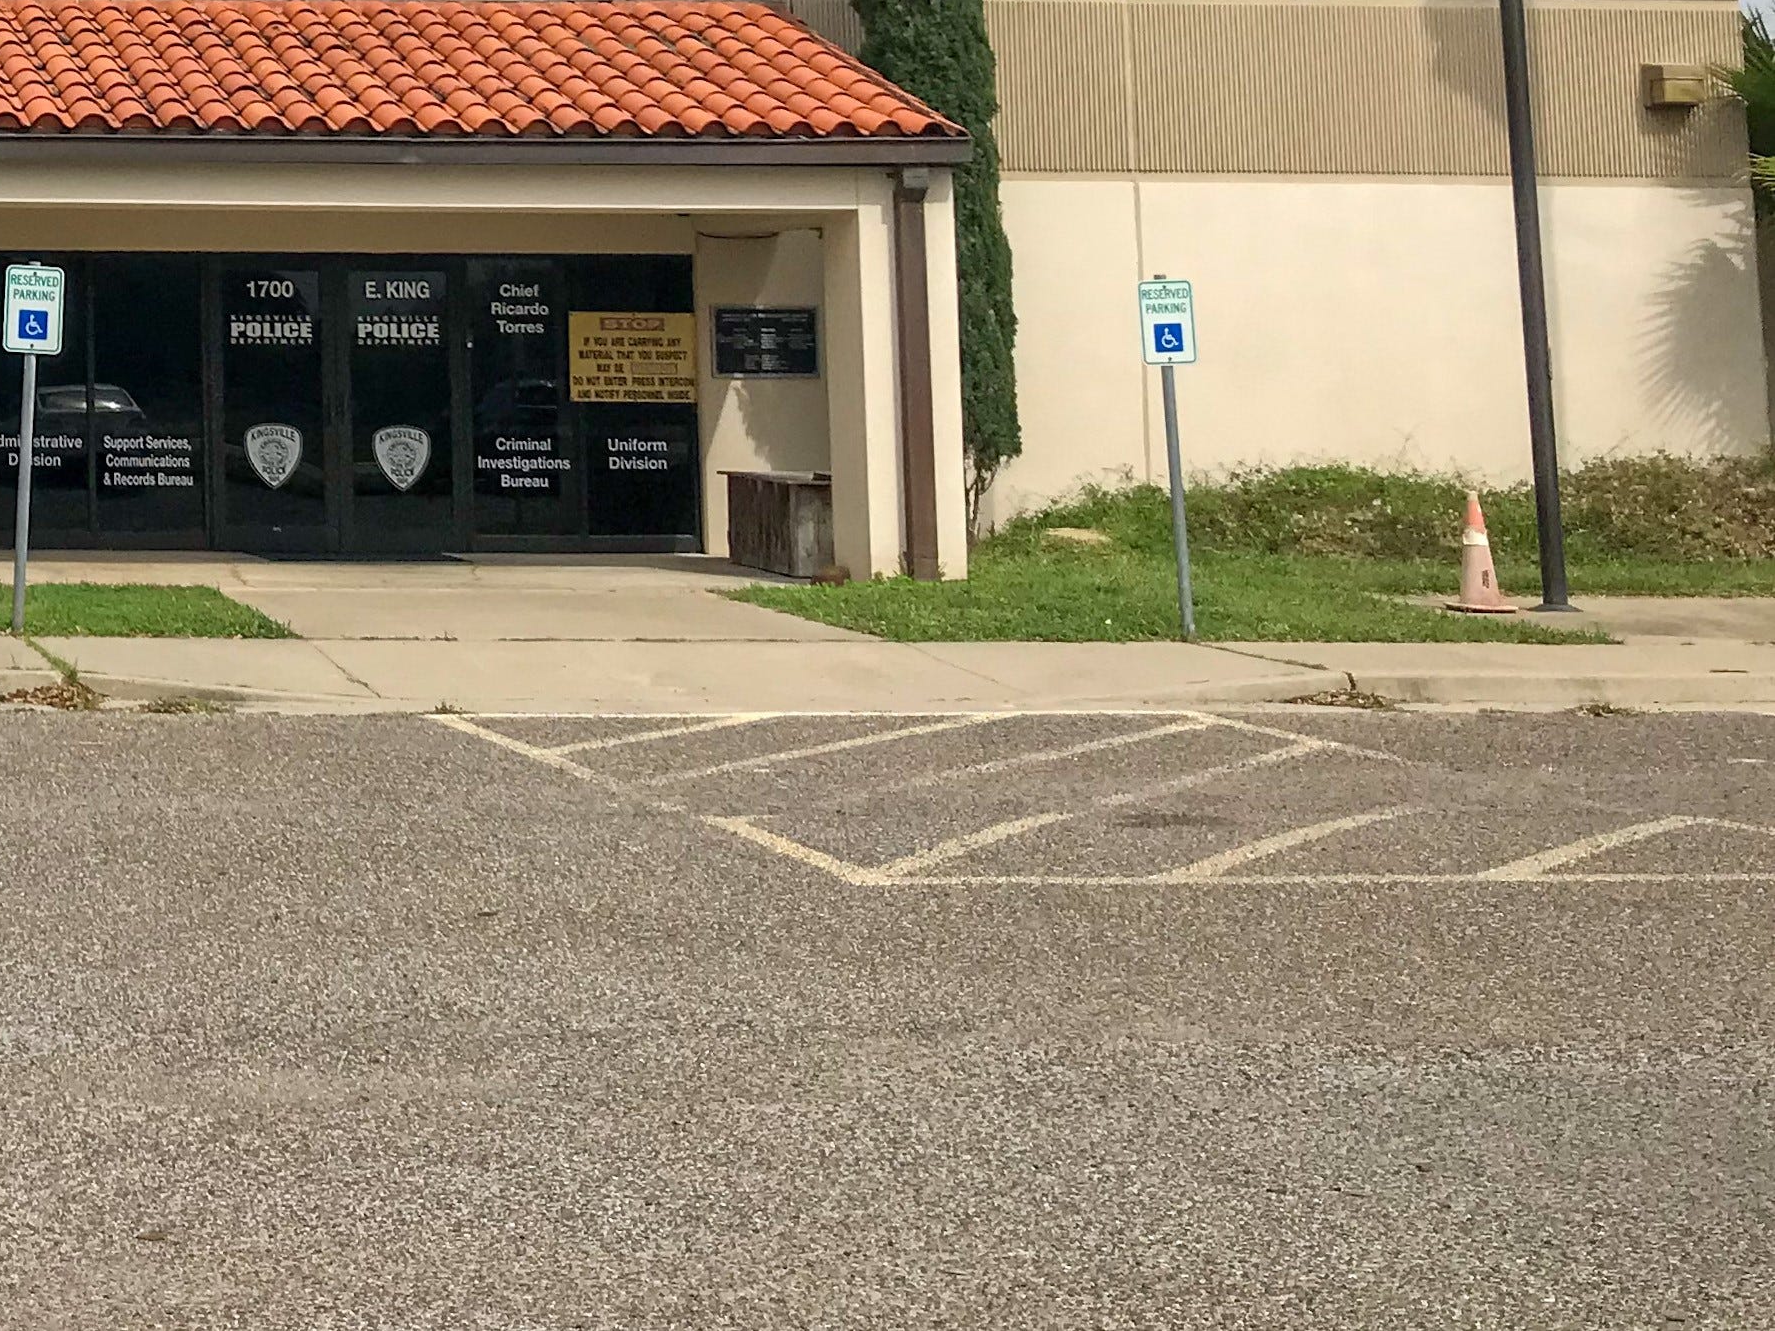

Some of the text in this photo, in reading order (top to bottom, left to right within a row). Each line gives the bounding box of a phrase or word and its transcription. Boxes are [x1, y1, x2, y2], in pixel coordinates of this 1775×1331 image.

[10, 274, 59, 288] RESERVED
[13, 289, 56, 302] PARKING
[246, 280, 294, 298] 1700
[365, 280, 431, 299] E. KING
[499, 284, 539, 297] Chief
[1141, 288, 1188, 300] RESERVED
[490, 302, 549, 315] Ricardo
[1145, 302, 1187, 314] PARKING
[230, 322, 313, 338] POLICE
[357, 323, 440, 338] POLICE
[496, 320, 544, 333] Torres
[357, 338, 440, 346] DEPARTMENT
[103, 435, 192, 451] Support Services,
[495, 437, 551, 451] Criminal
[607, 438, 668, 451] Uniform
[105, 453, 191, 468] Communications
[477, 456, 571, 471] Investigations
[608, 457, 668, 470] Division
[103, 472, 194, 486] & Records Bureau
[500, 474, 549, 488] Bureau
